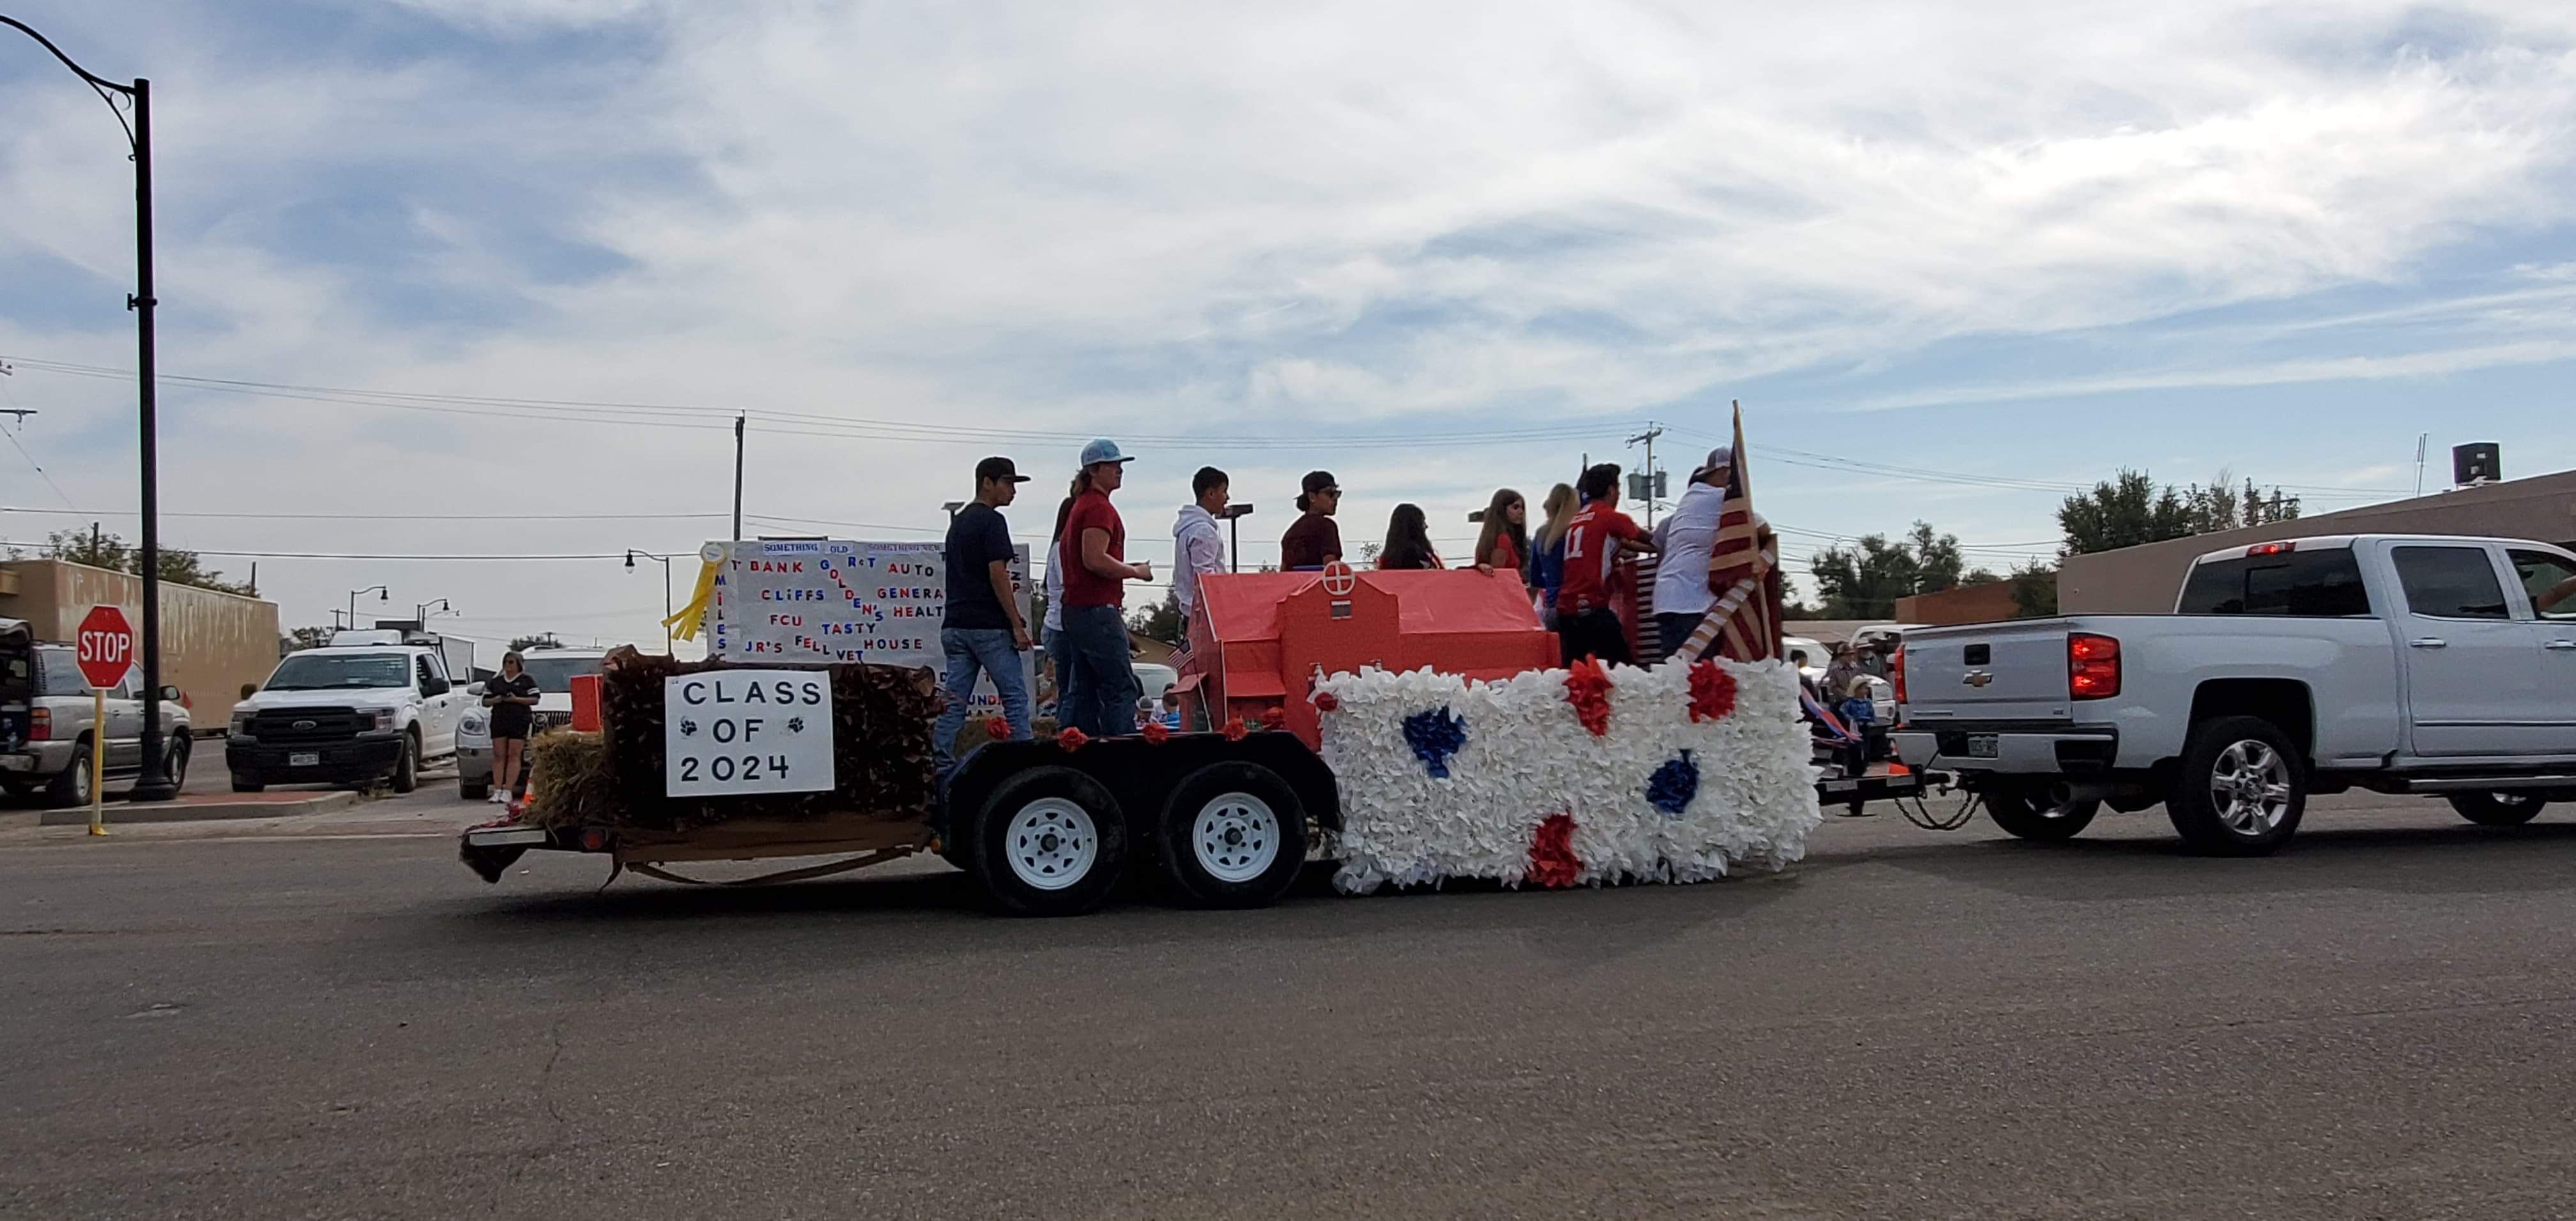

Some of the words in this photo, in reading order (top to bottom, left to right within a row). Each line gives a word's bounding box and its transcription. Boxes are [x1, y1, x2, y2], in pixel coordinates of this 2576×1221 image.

[764, 543, 818, 551] SOMETHING
[830, 545, 848, 553] OLD
[1563, 525, 1584, 561] 11
[750, 560, 803, 573] BANK
[888, 562, 934, 577] AUTO
[877, 587, 944, 600] GENERA
[893, 606, 944, 618] HEALT
[770, 615, 802, 627] FCU
[822, 622, 876, 635] TASTY
[80, 630, 130, 663] STOP
[745, 640, 783, 654] JR'S
[795, 635, 831, 656] FELL
[864, 638, 923, 650] HOUSE
[836, 649, 864, 661] VET
[682, 680, 822, 705] CLASS
[712, 718, 764, 744] OF
[680, 755, 790, 782] 2024
